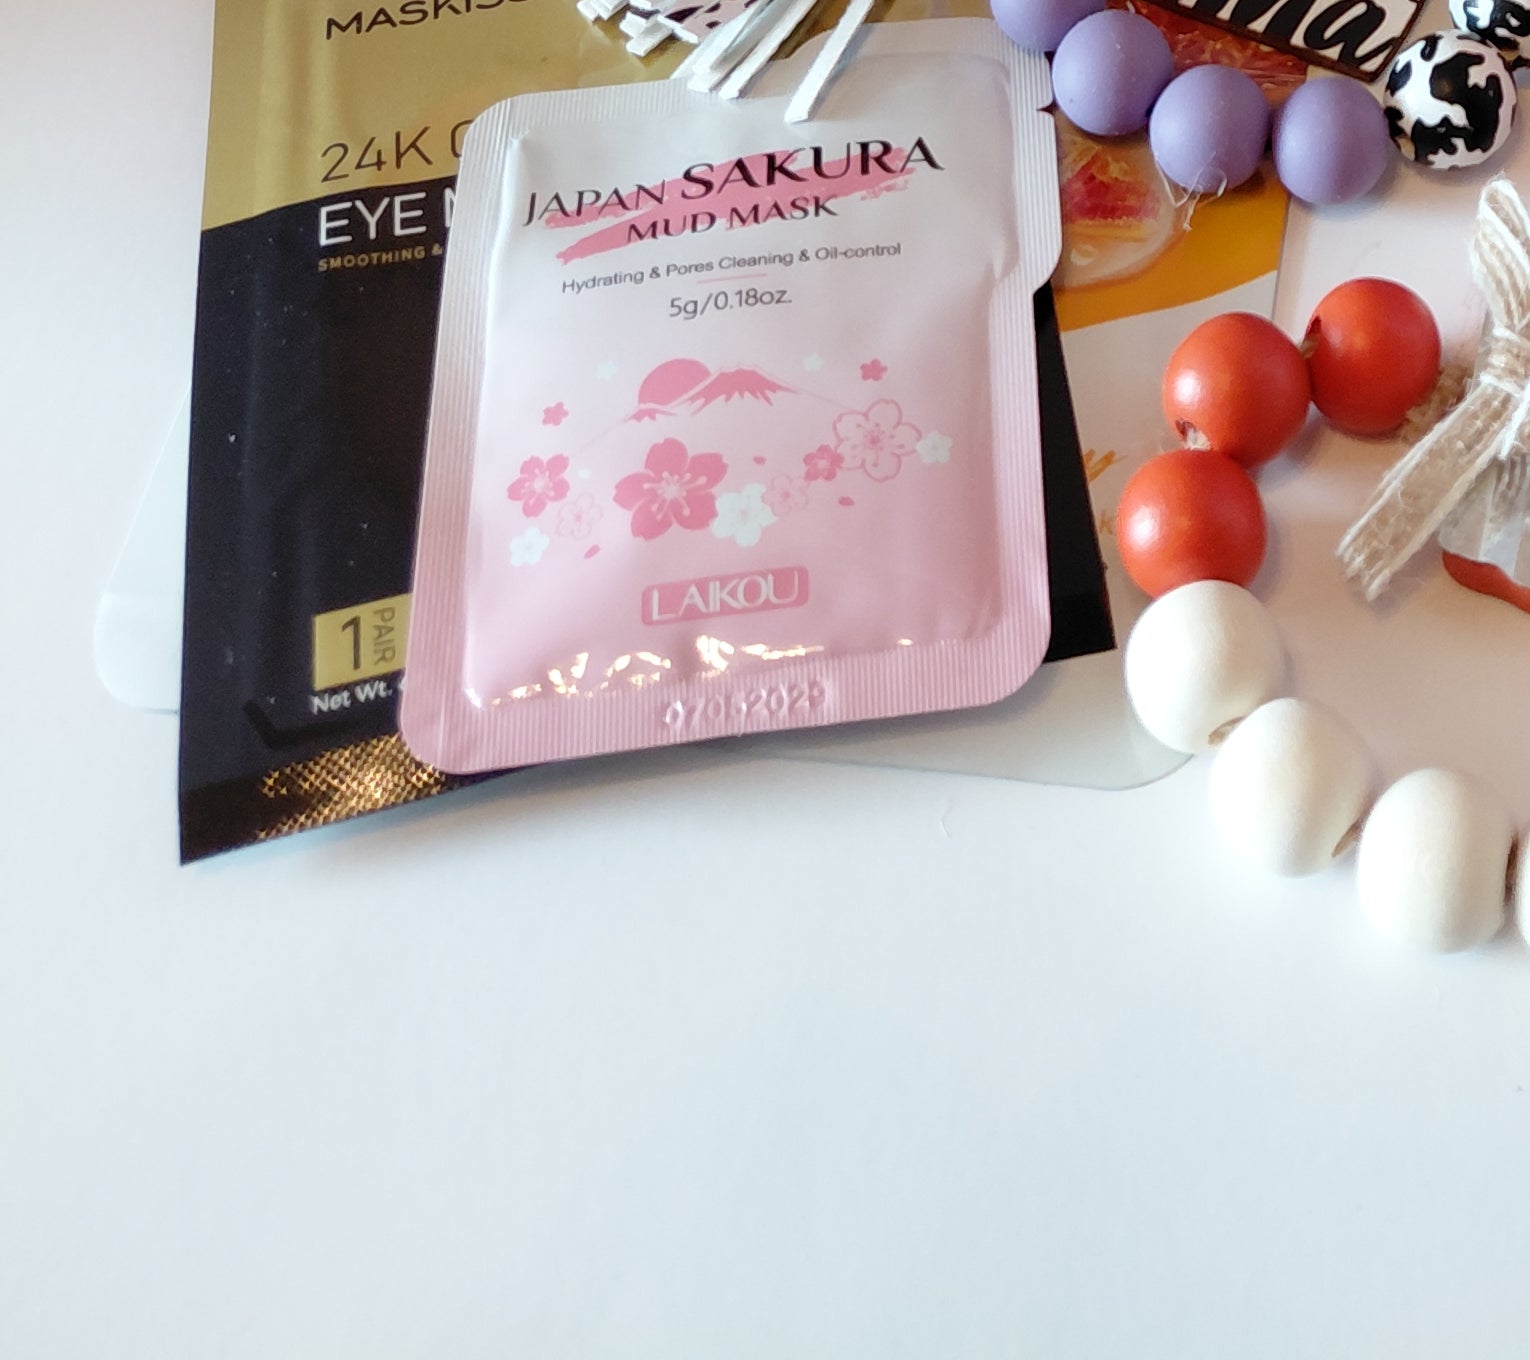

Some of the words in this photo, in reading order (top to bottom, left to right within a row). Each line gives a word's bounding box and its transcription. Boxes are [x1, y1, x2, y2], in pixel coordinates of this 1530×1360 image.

[321, 126, 433, 183] 24K
[522, 179, 667, 227] JAPAN
[680, 136, 946, 201] SAKURA
[319, 192, 427, 246] EYE
[626, 211, 717, 244] MUD
[727, 194, 840, 230] MASK
[318, 246, 426, 272] SMOOTHING
[431, 243, 443, 256] &
[562, 270, 644, 294] Hydrating
[649, 265, 661, 279] &
[666, 261, 714, 277] Pores
[718, 249, 794, 271] Cleaning
[799, 248, 810, 262] &
[815, 243, 902, 260] Oil-control
[652, 570, 799, 621] LAIKOU
[342, 615, 361, 671] 1
[373, 607, 396, 666] PAIR
[311, 690, 352, 715] Net
[354, 680, 393, 703] Wt.
